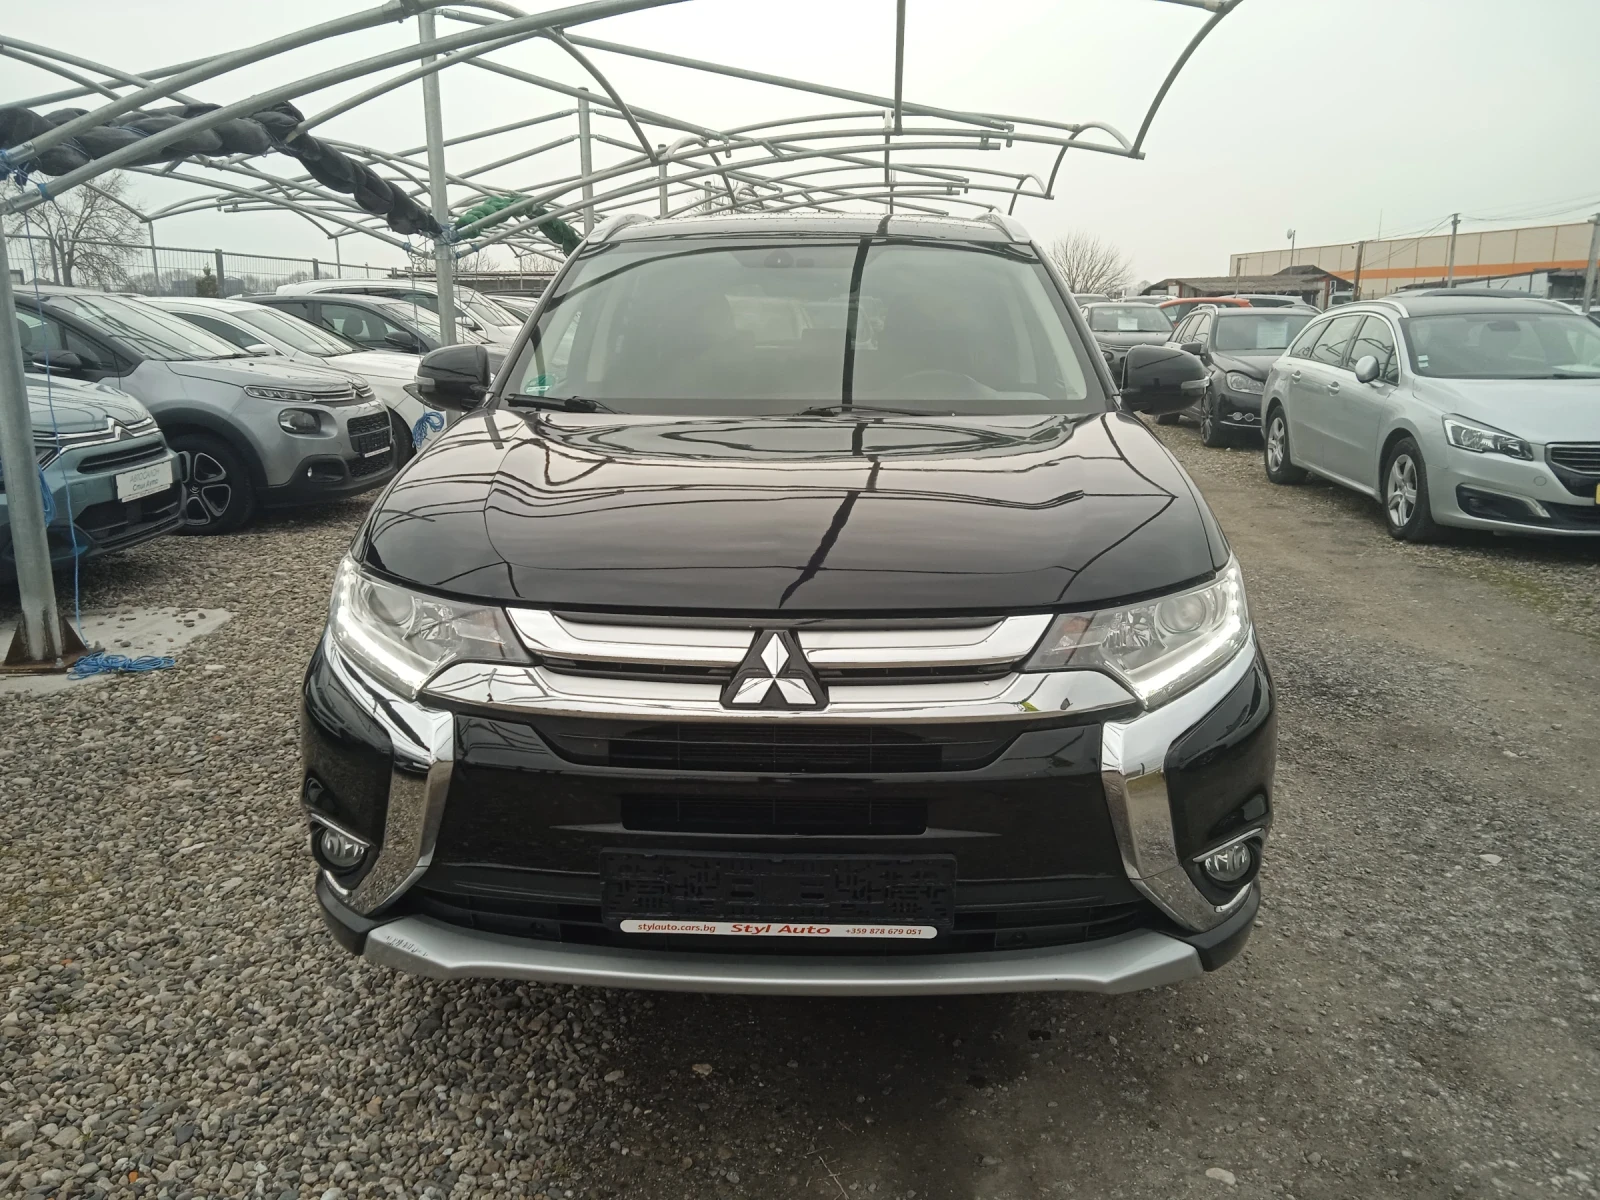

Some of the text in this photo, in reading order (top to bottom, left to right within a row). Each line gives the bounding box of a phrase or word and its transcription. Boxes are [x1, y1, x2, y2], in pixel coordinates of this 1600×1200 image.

[637, 923, 716, 933] stylauto.cars.bg
[730, 923, 772, 935] Styl
[777, 924, 831, 935] Auto
[845, 927, 868, 935] +359
[869, 927, 886, 935] 878
[906, 928, 923, 936] 051
